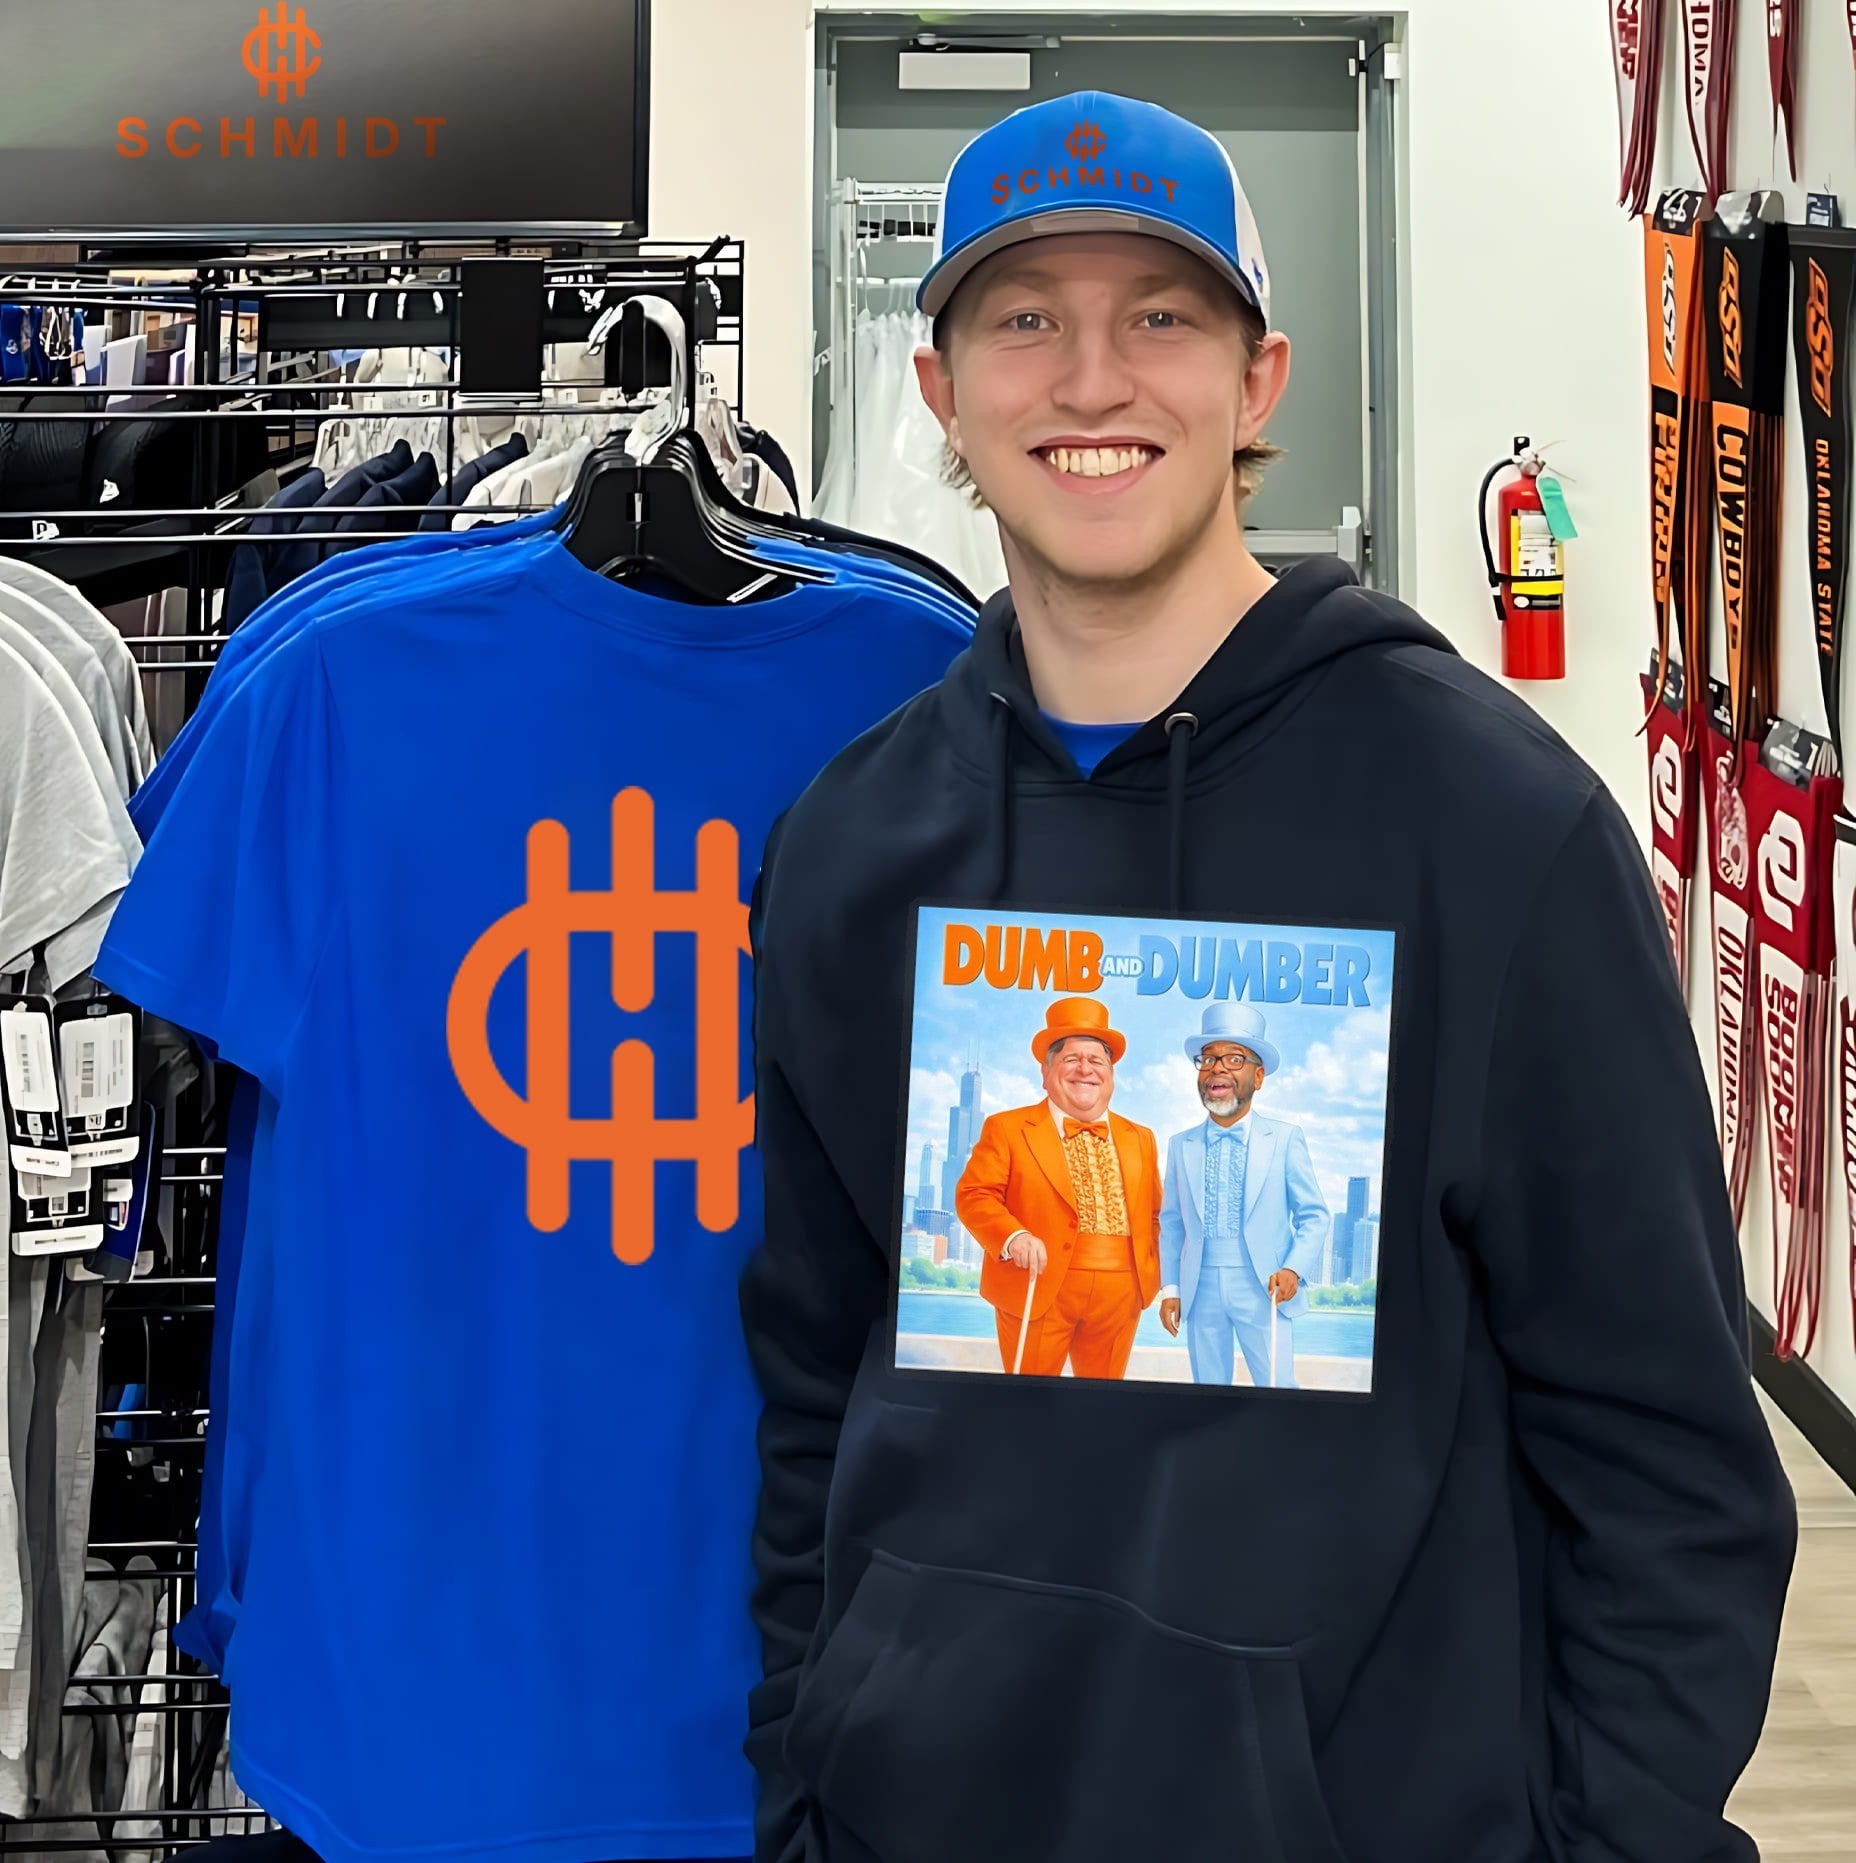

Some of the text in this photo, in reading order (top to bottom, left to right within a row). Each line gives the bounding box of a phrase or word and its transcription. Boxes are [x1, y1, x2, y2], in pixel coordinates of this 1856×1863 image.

[116, 117, 447, 158] SCHMIDT
[991, 167, 1179, 204] SCHMIDT
[1815, 439, 1832, 570] OKLAHOMA
[943, 924, 1371, 1008] DUMB AND DUMBER
